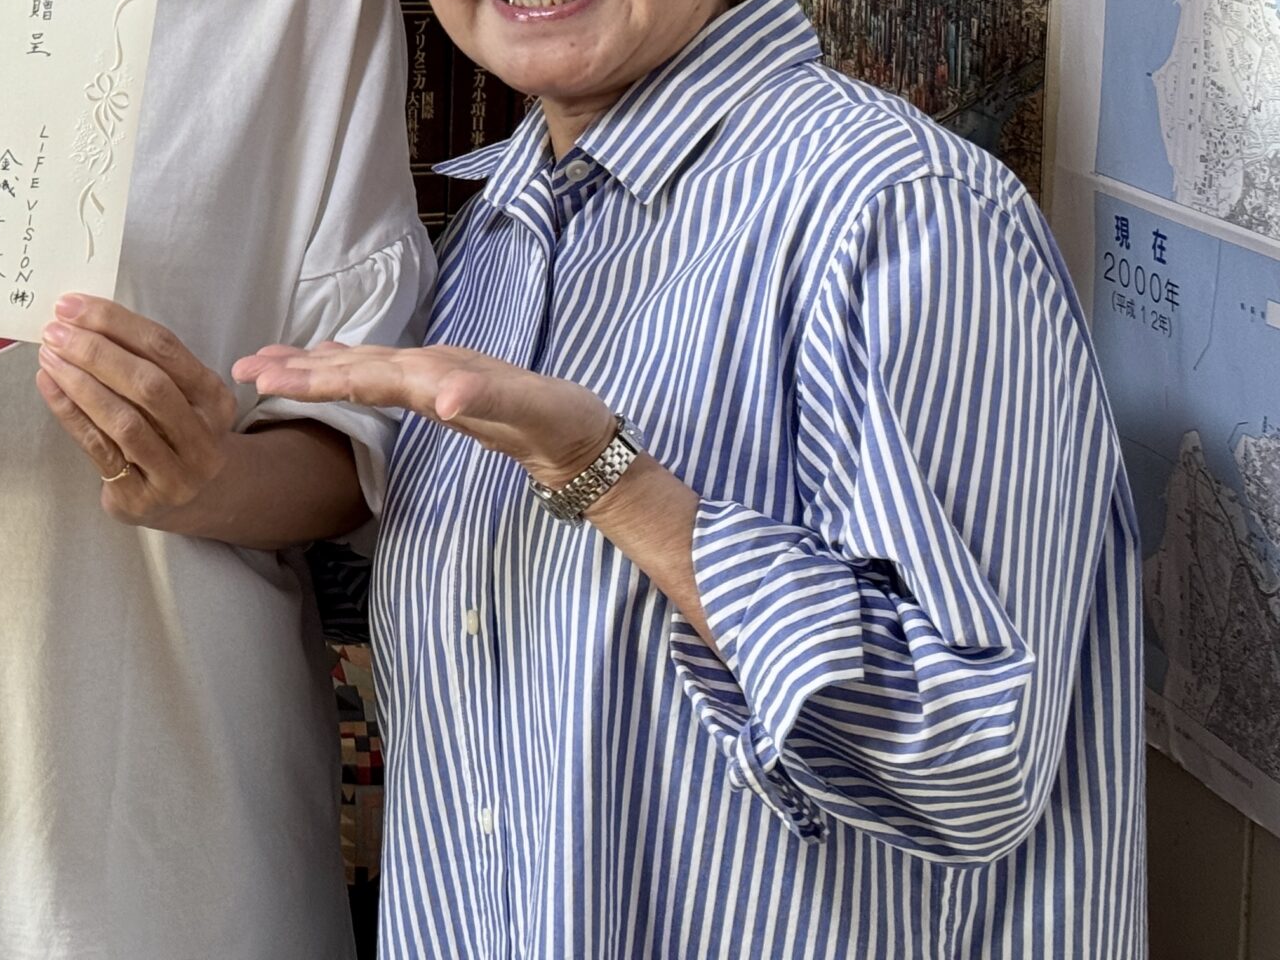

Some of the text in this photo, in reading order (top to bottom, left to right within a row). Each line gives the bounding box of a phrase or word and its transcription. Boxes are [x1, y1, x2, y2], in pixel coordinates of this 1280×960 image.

[28, 124, 50, 191] LIFE
[14, 198, 40, 285] VISION
[1114, 214, 1168, 265] 現在
[1103, 251, 1180, 313] 2000年
